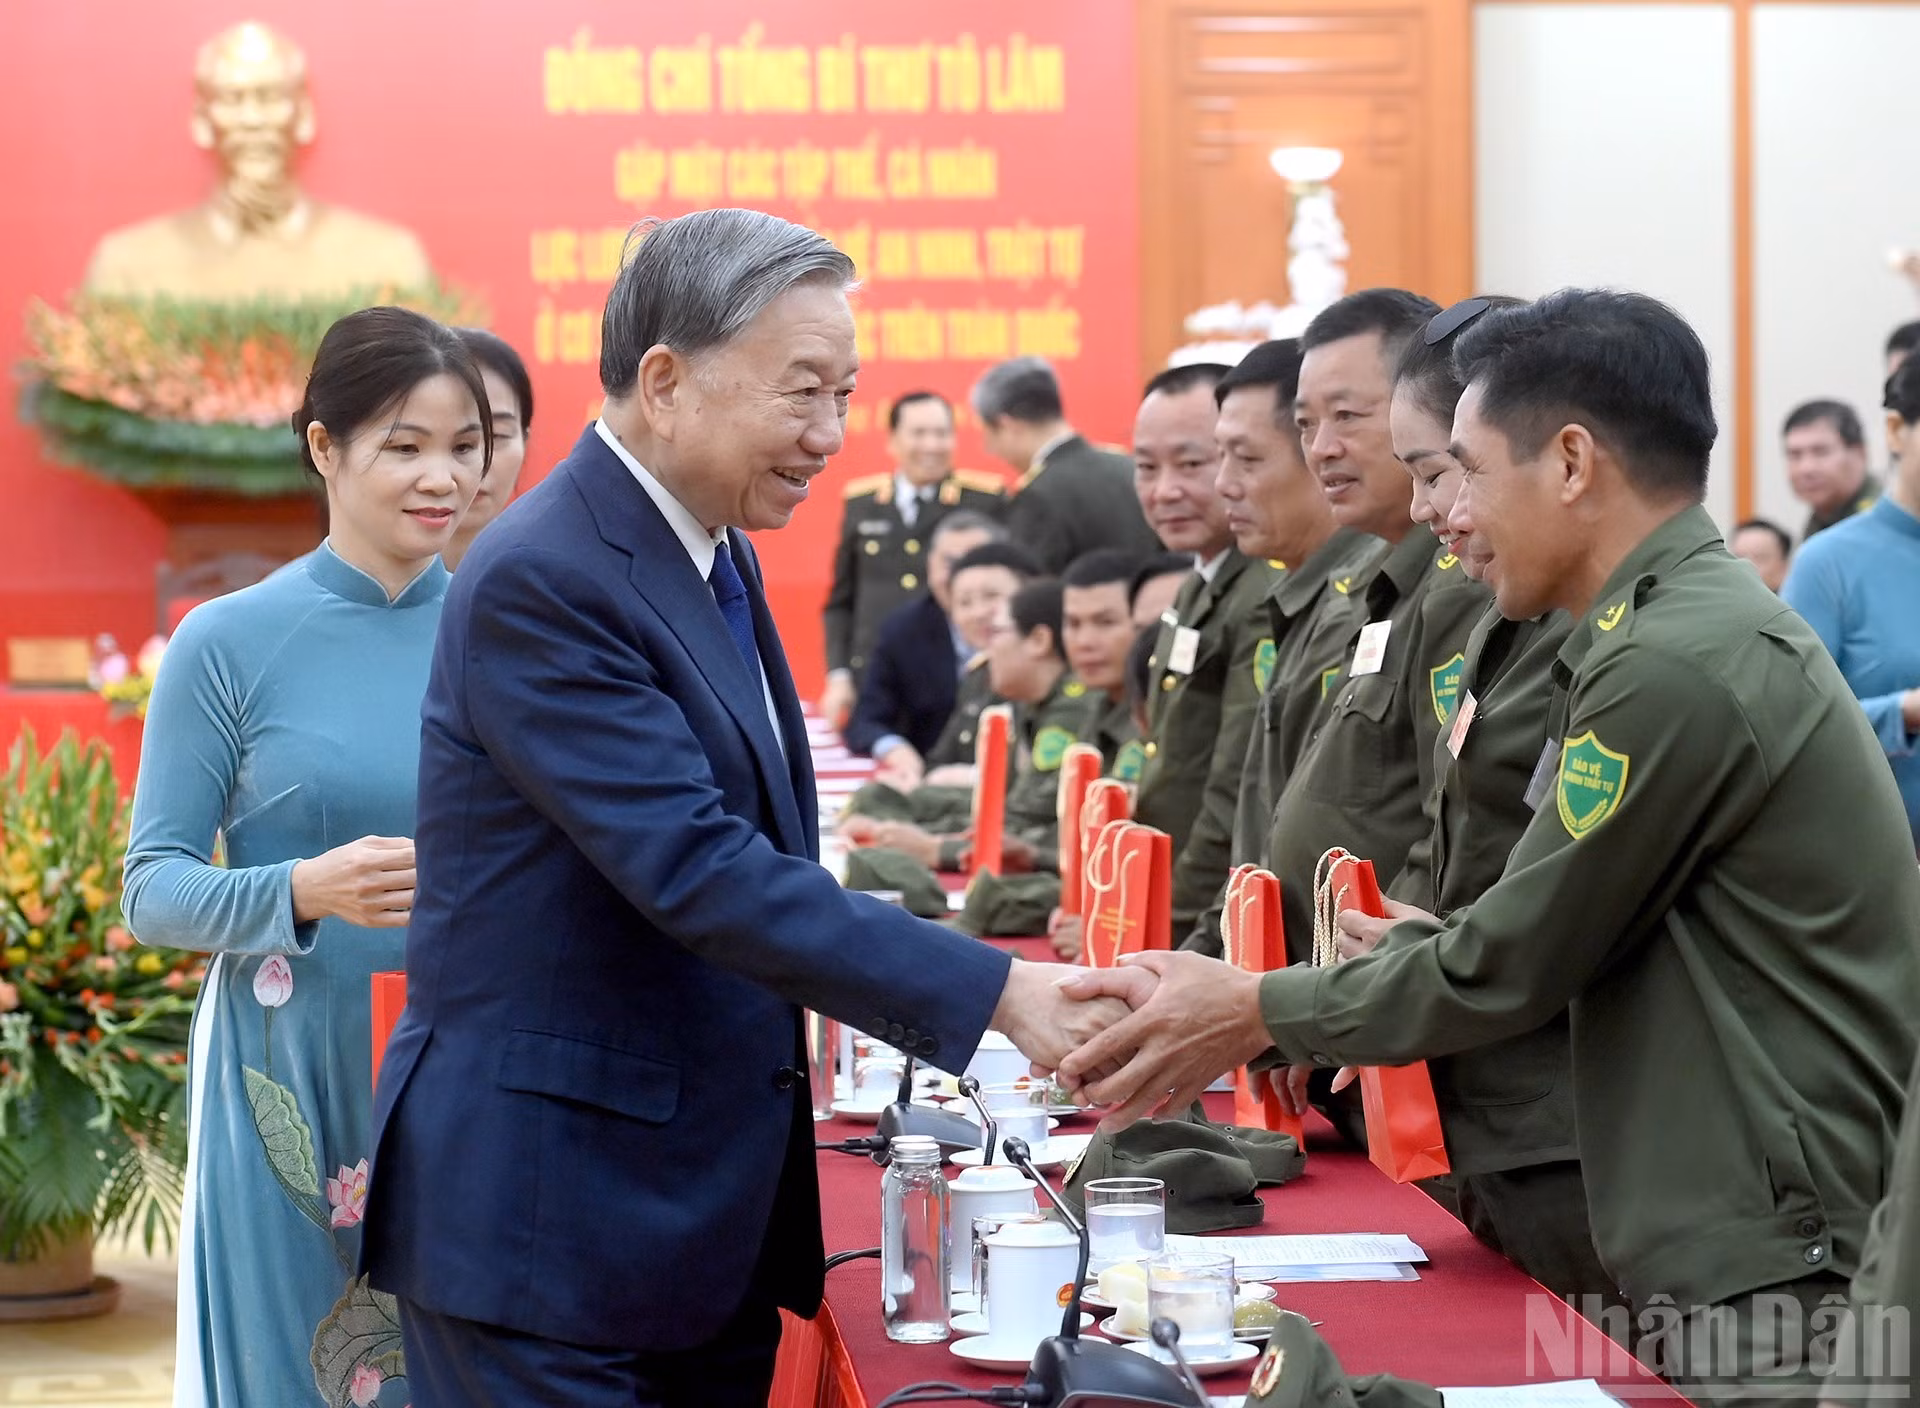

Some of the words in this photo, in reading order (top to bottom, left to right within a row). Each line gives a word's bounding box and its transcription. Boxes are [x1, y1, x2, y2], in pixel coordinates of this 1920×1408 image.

[544, 22, 643, 114] ĐỒNG
[649, 30, 712, 114] CHÍ
[718, 22, 811, 114] TỔNG
[817, 30, 857, 114] BÍ
[863, 42, 934, 114] THƯ
[937, 30, 982, 114] TÔ
[987, 30, 1065, 114] LÂM
